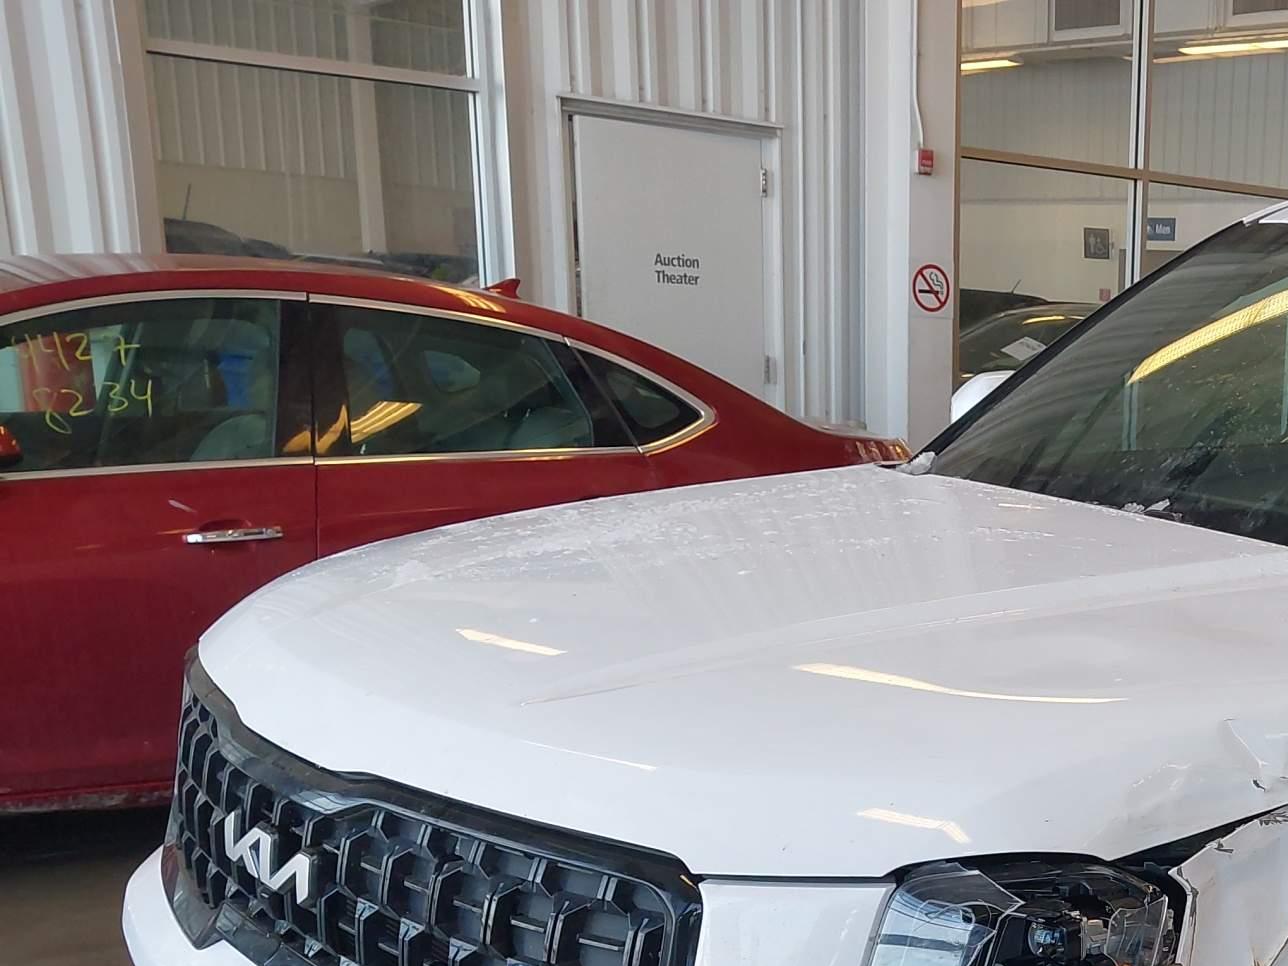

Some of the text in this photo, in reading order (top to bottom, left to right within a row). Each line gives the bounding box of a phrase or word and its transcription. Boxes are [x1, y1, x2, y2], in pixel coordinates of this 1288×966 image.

[1155, 224, 1171, 234] Men
[654, 253, 700, 270] Auction
[654, 271, 700, 286] Theater
